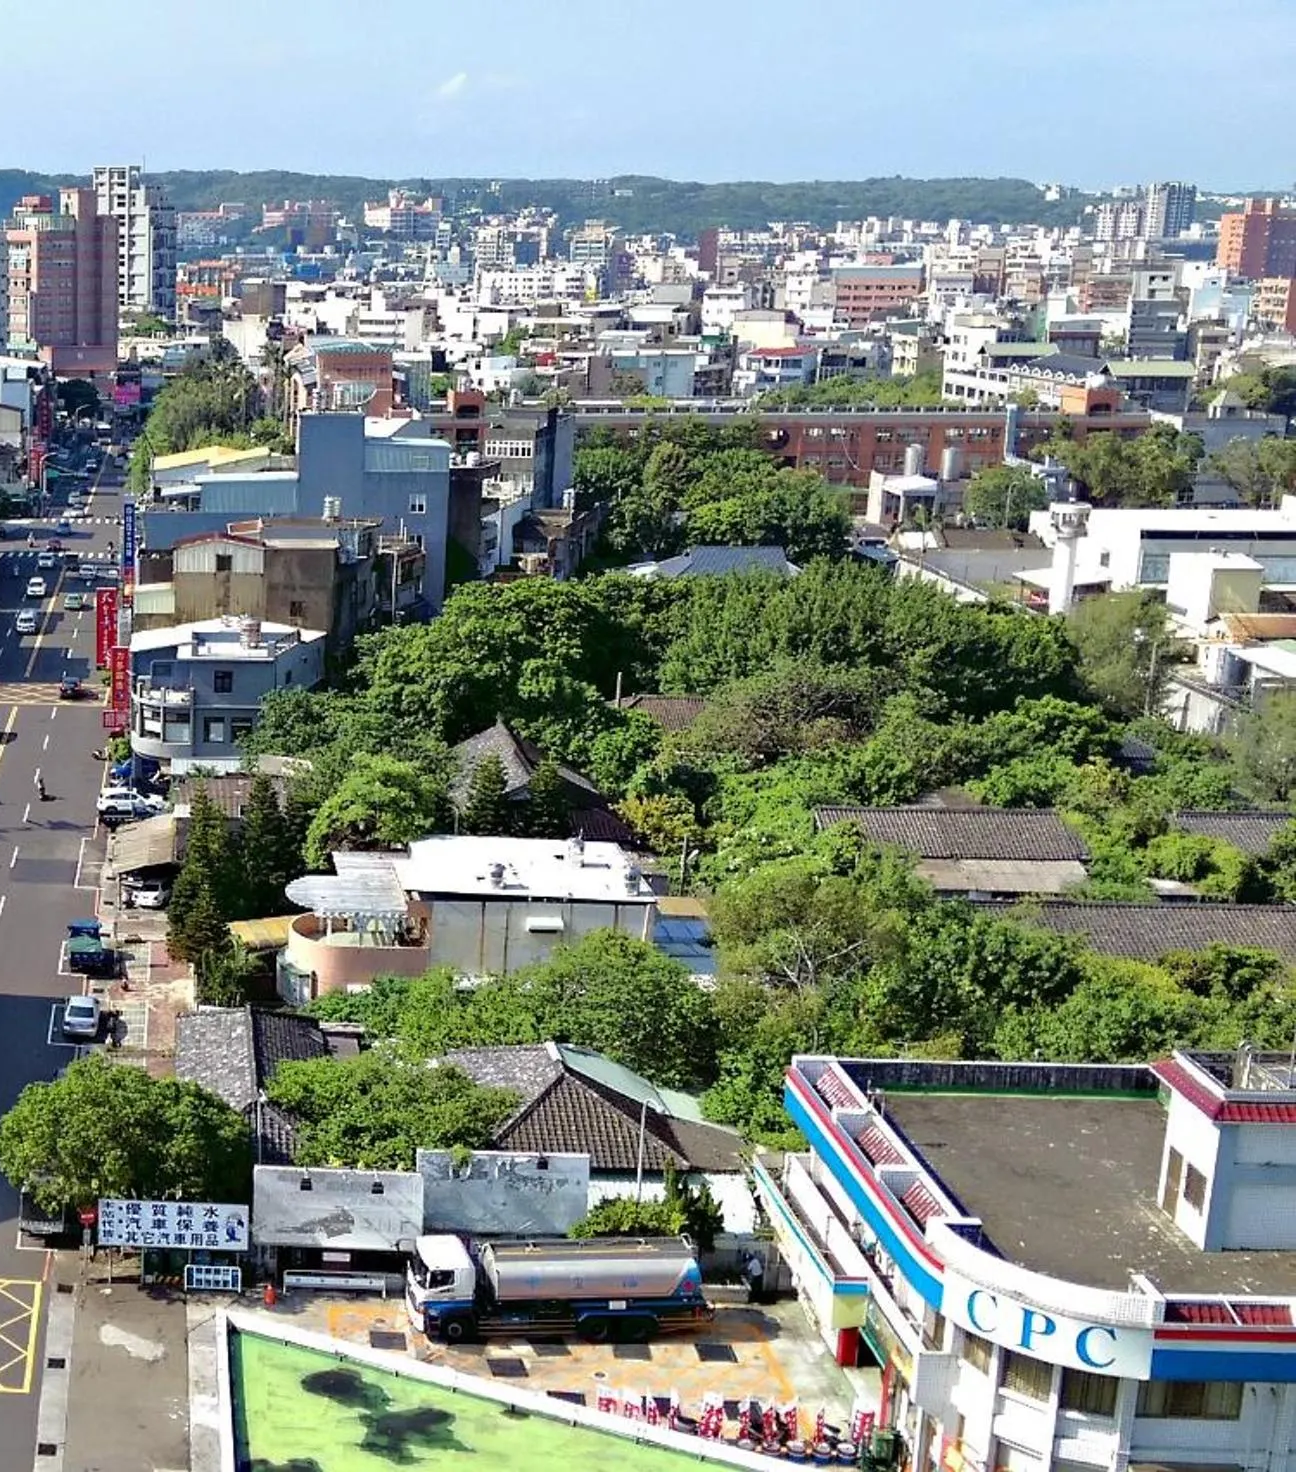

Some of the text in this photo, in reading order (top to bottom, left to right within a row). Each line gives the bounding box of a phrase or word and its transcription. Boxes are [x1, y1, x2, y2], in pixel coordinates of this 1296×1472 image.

[125, 1202, 220, 1219] 優質純水
[125, 1216, 220, 1233] 汽車保養
[125, 1231, 220, 1247] 其它汽車用品
[966, 1289, 1118, 1369] CPC
